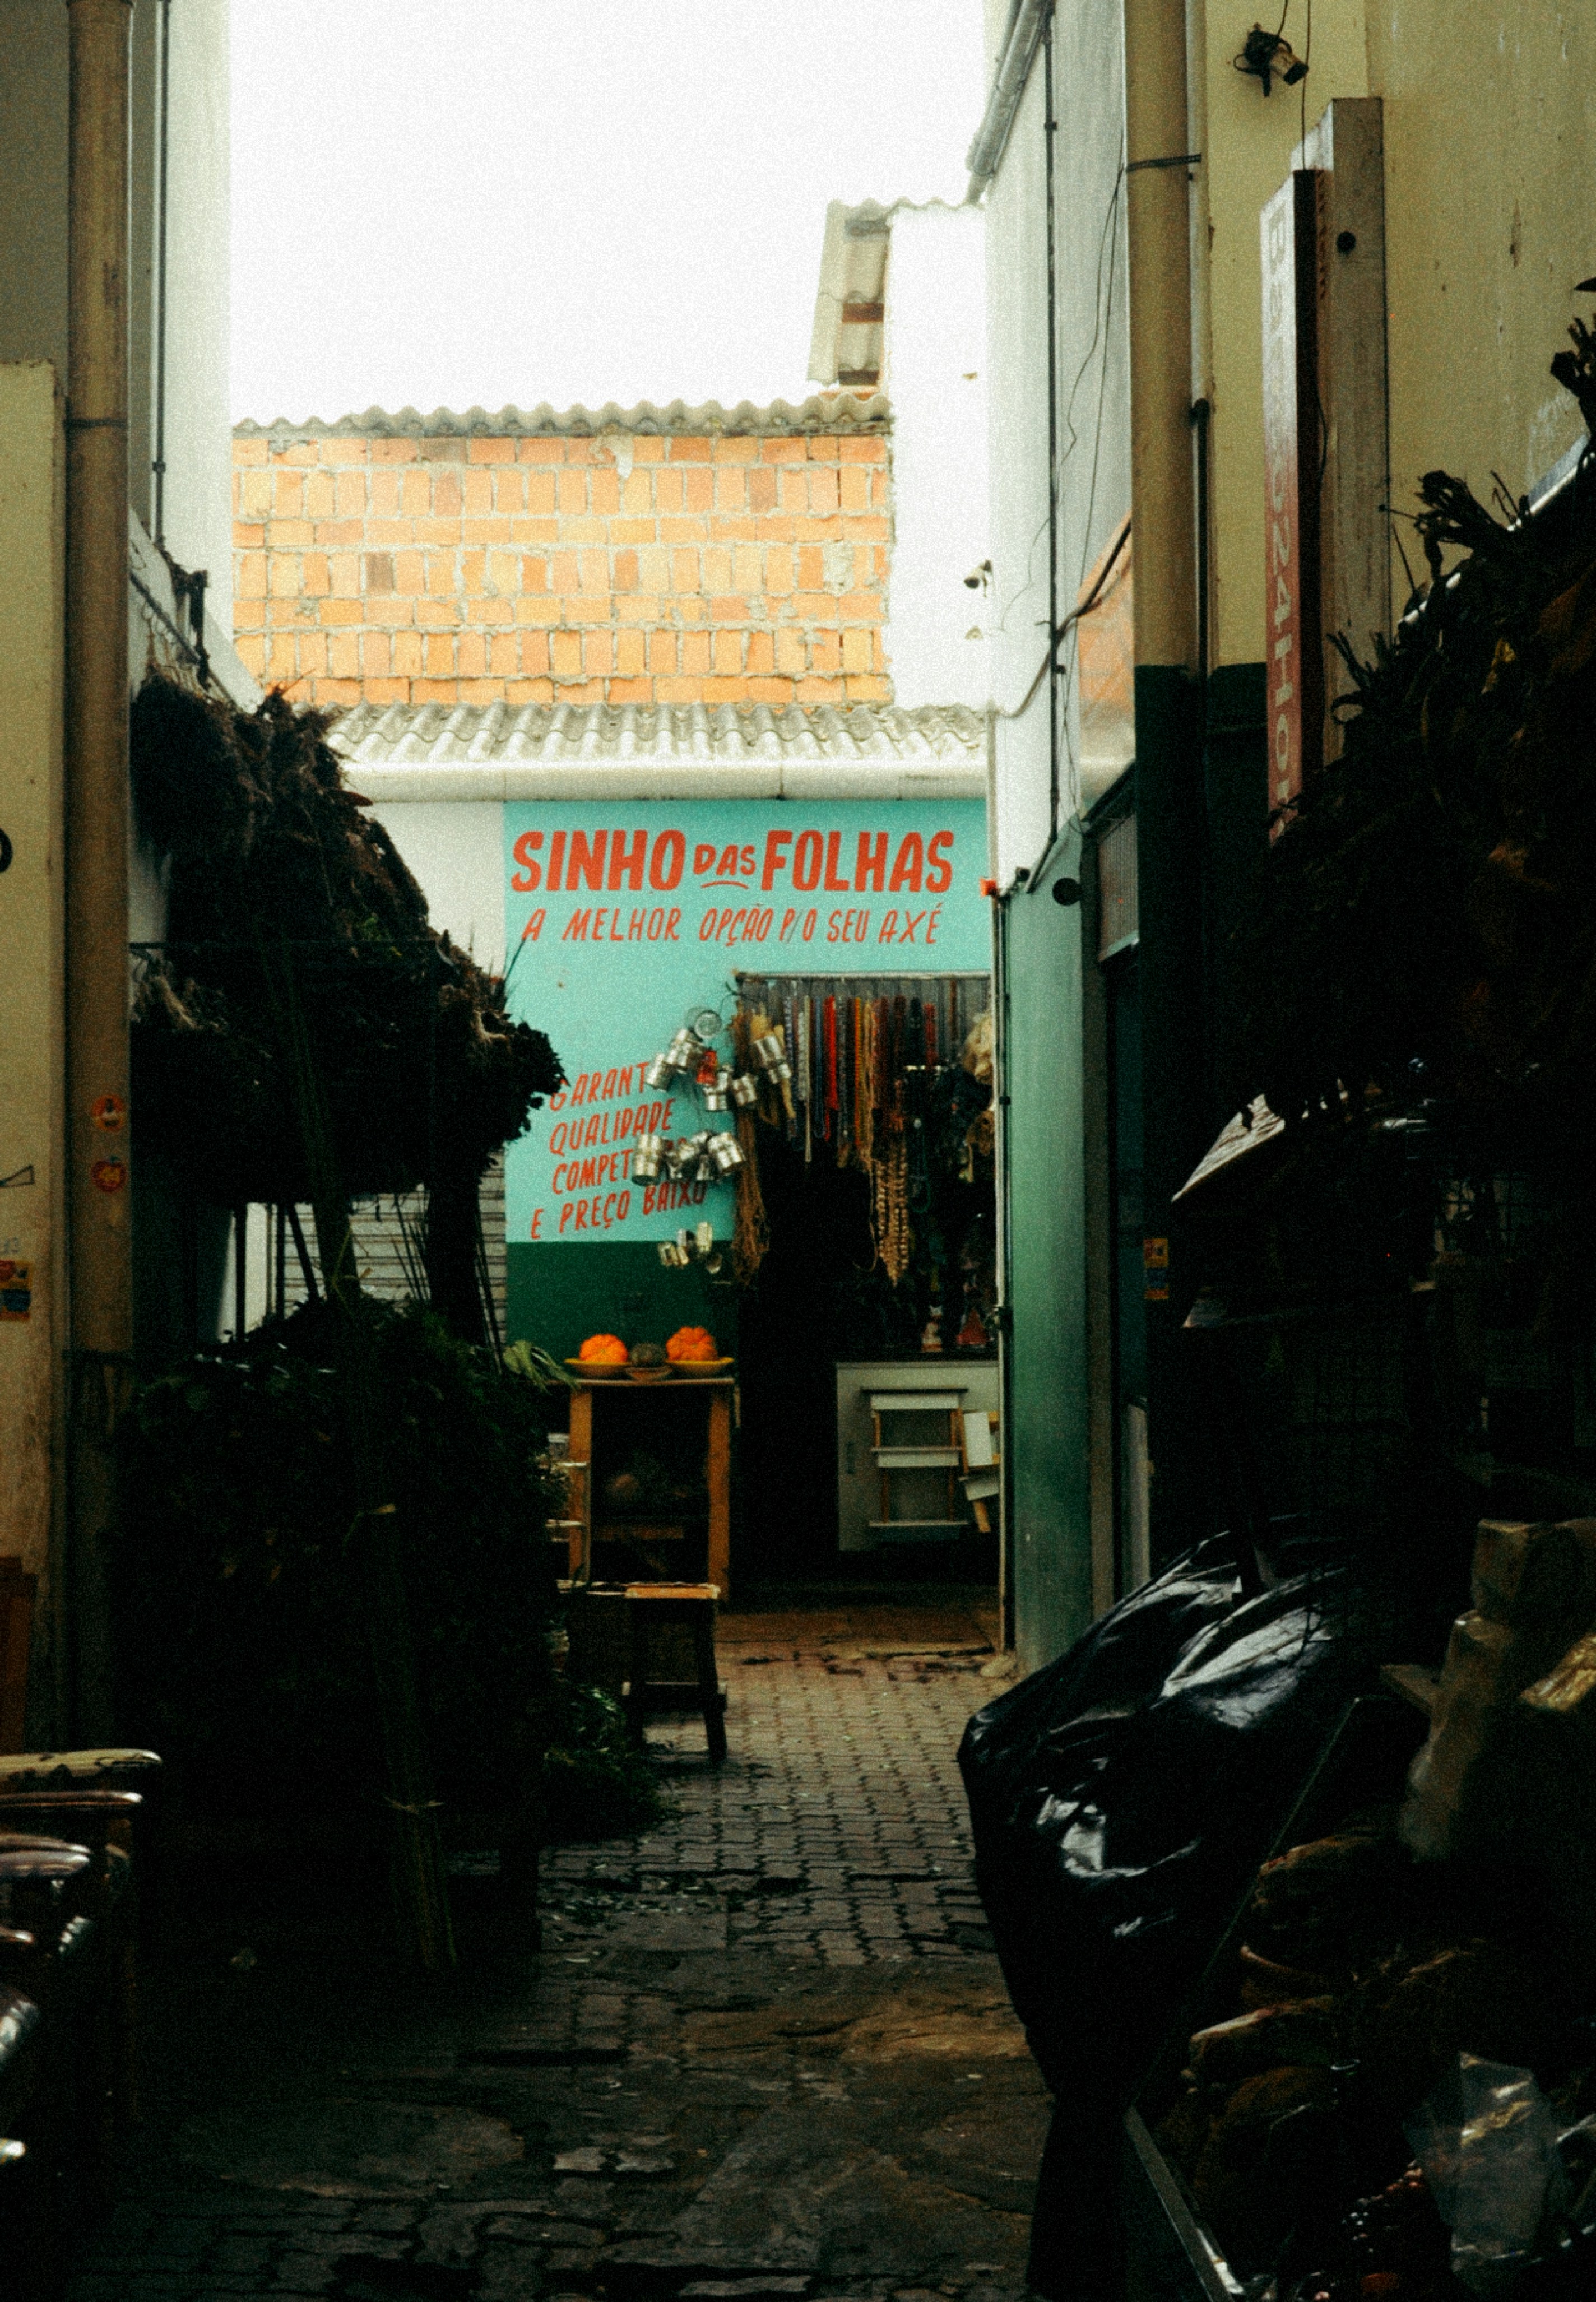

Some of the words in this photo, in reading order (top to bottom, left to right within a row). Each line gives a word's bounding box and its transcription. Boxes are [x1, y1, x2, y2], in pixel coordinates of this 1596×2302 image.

[511, 829, 686, 892] SINHO
[693, 843, 757, 876] DAS
[760, 829, 954, 893] FOLHAS
[521, 908, 546, 941] A
[562, 907, 682, 941] MELHOR
[699, 902, 774, 947] OPÇÃO
[827, 907, 871, 943] SEU
[878, 901, 944, 944] AXÉ
[549, 1098, 676, 1157] QUALIDADE
[530, 1208, 544, 1240] E
[559, 1190, 632, 1234] PREÇO
[642, 1180, 710, 1215] BAIXO
